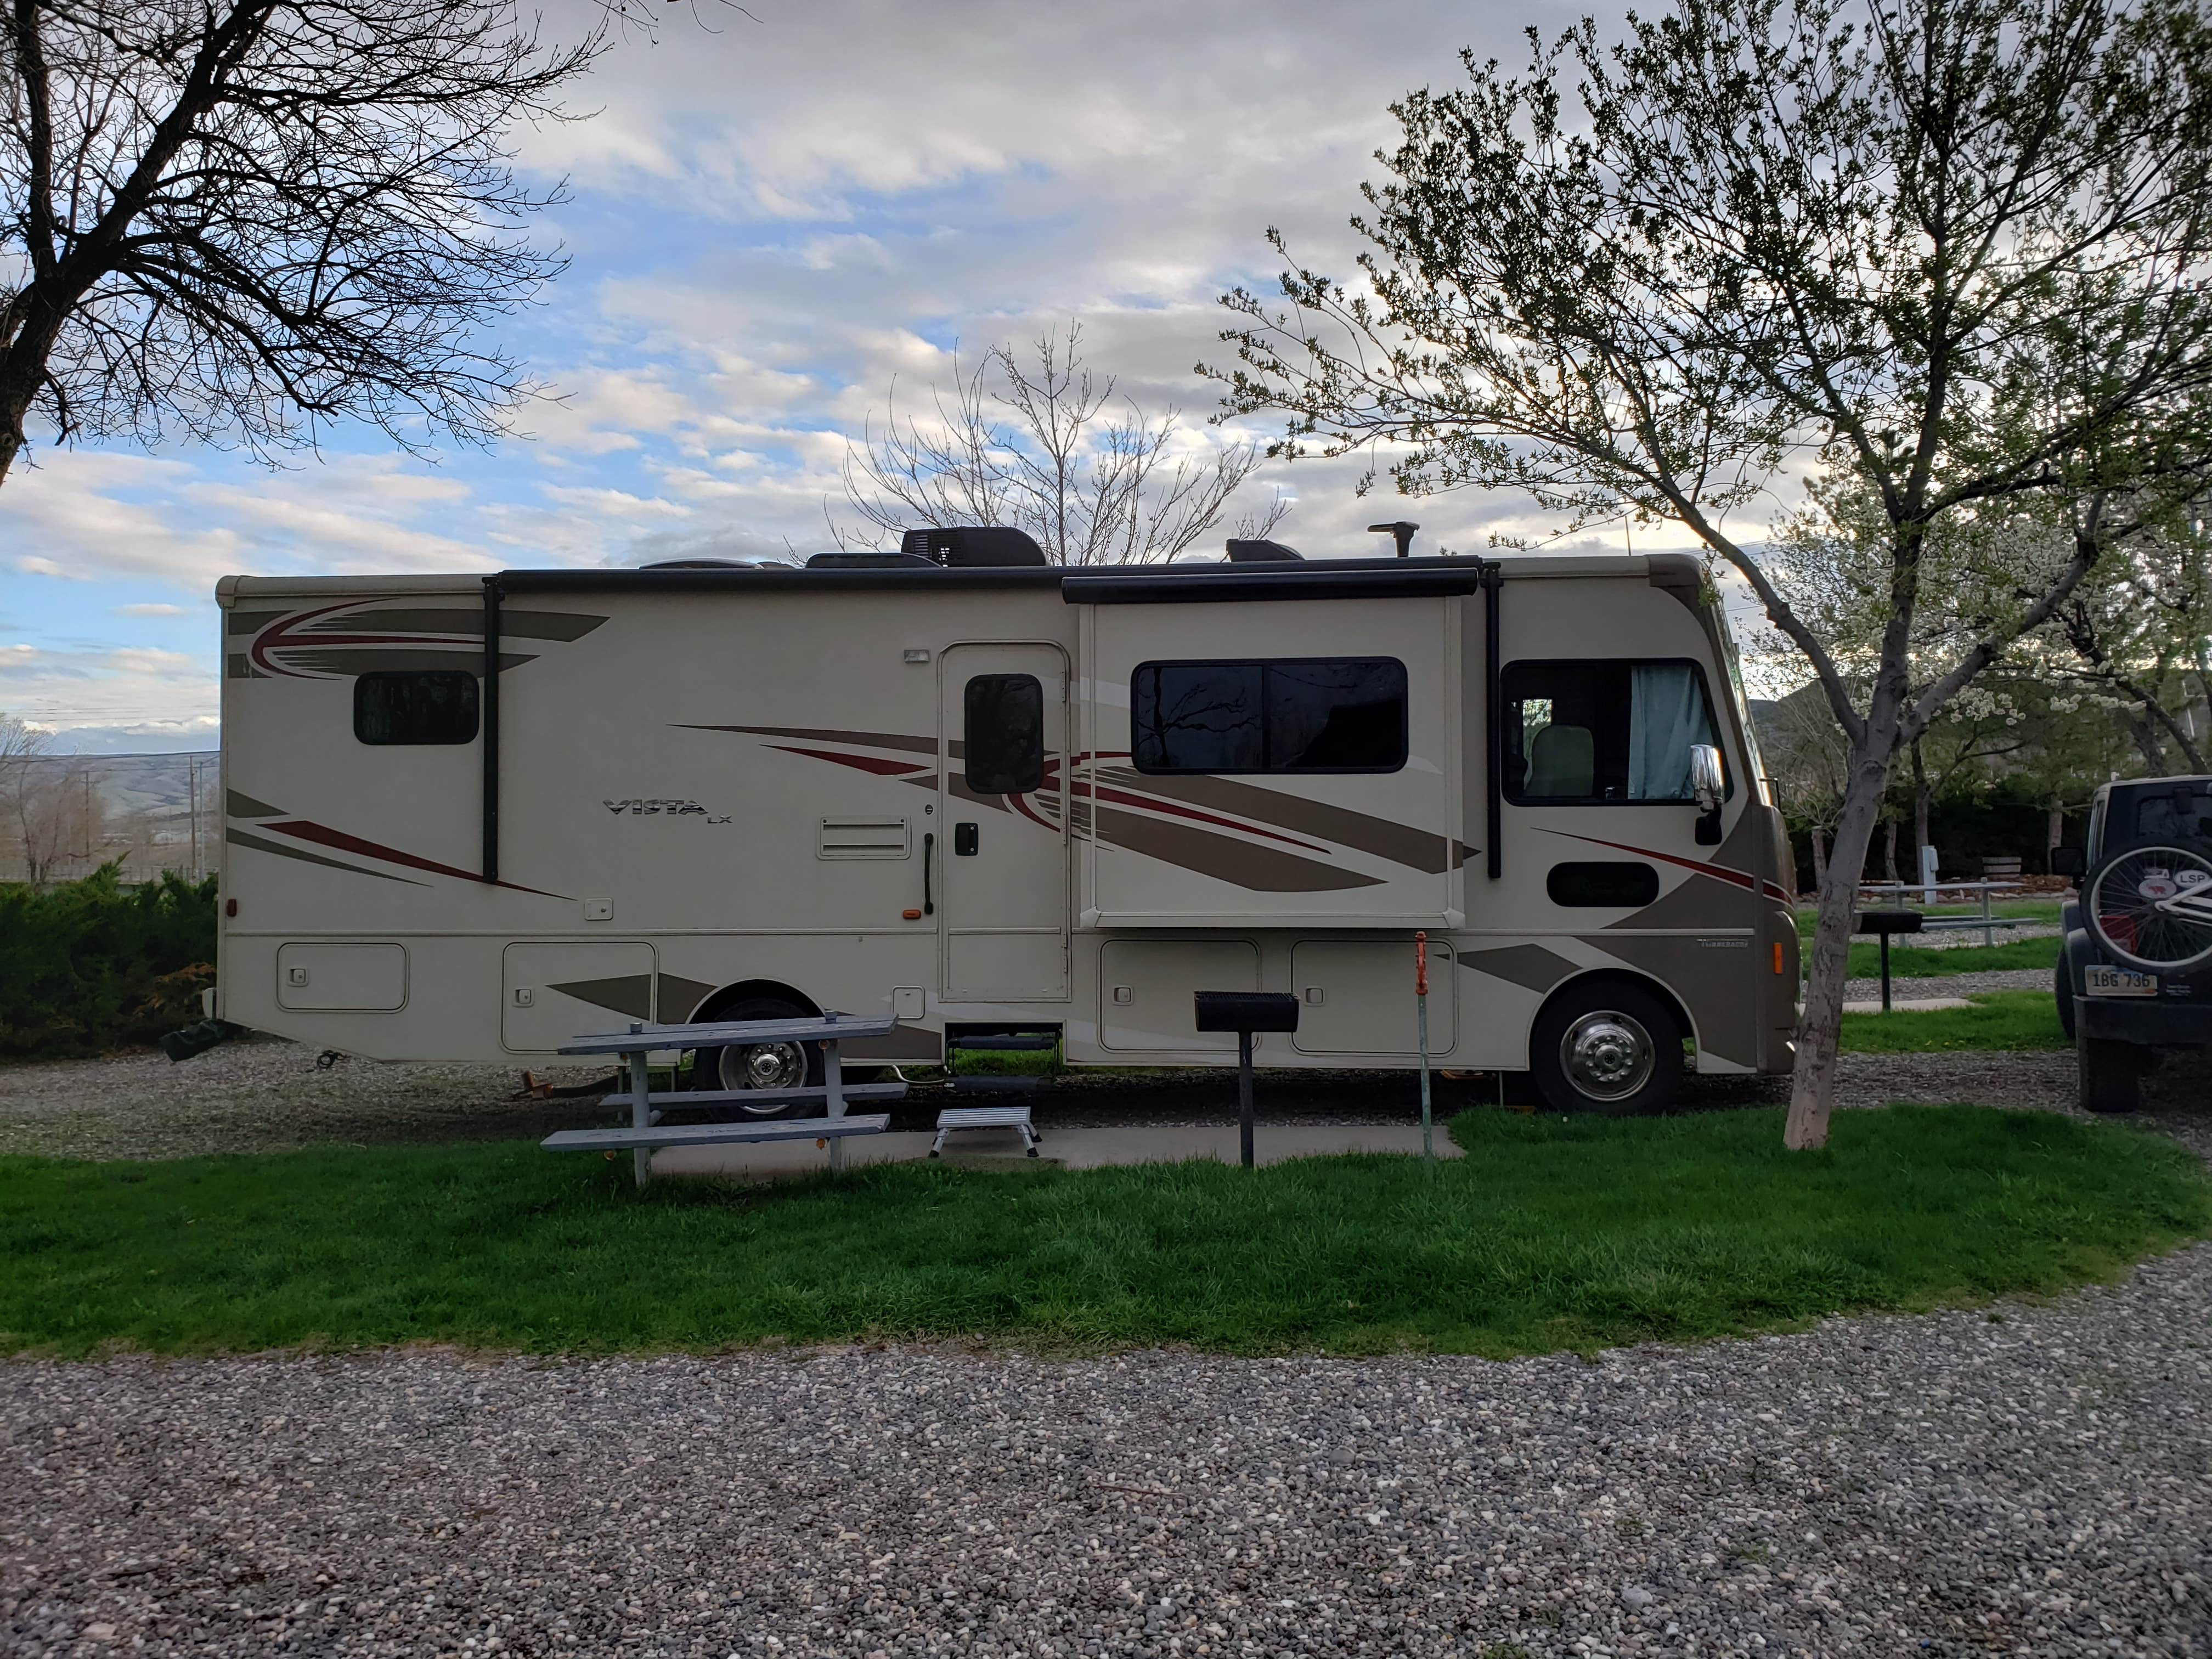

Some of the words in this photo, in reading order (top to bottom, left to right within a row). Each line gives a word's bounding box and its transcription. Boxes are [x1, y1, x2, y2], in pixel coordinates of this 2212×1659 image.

[602, 799, 708, 815] VISTA
[707, 815, 733, 824] LX
[2180, 874, 2205, 883] LSP
[2093, 973, 2119, 987] 1BG
[2124, 973, 2150, 987] 736
